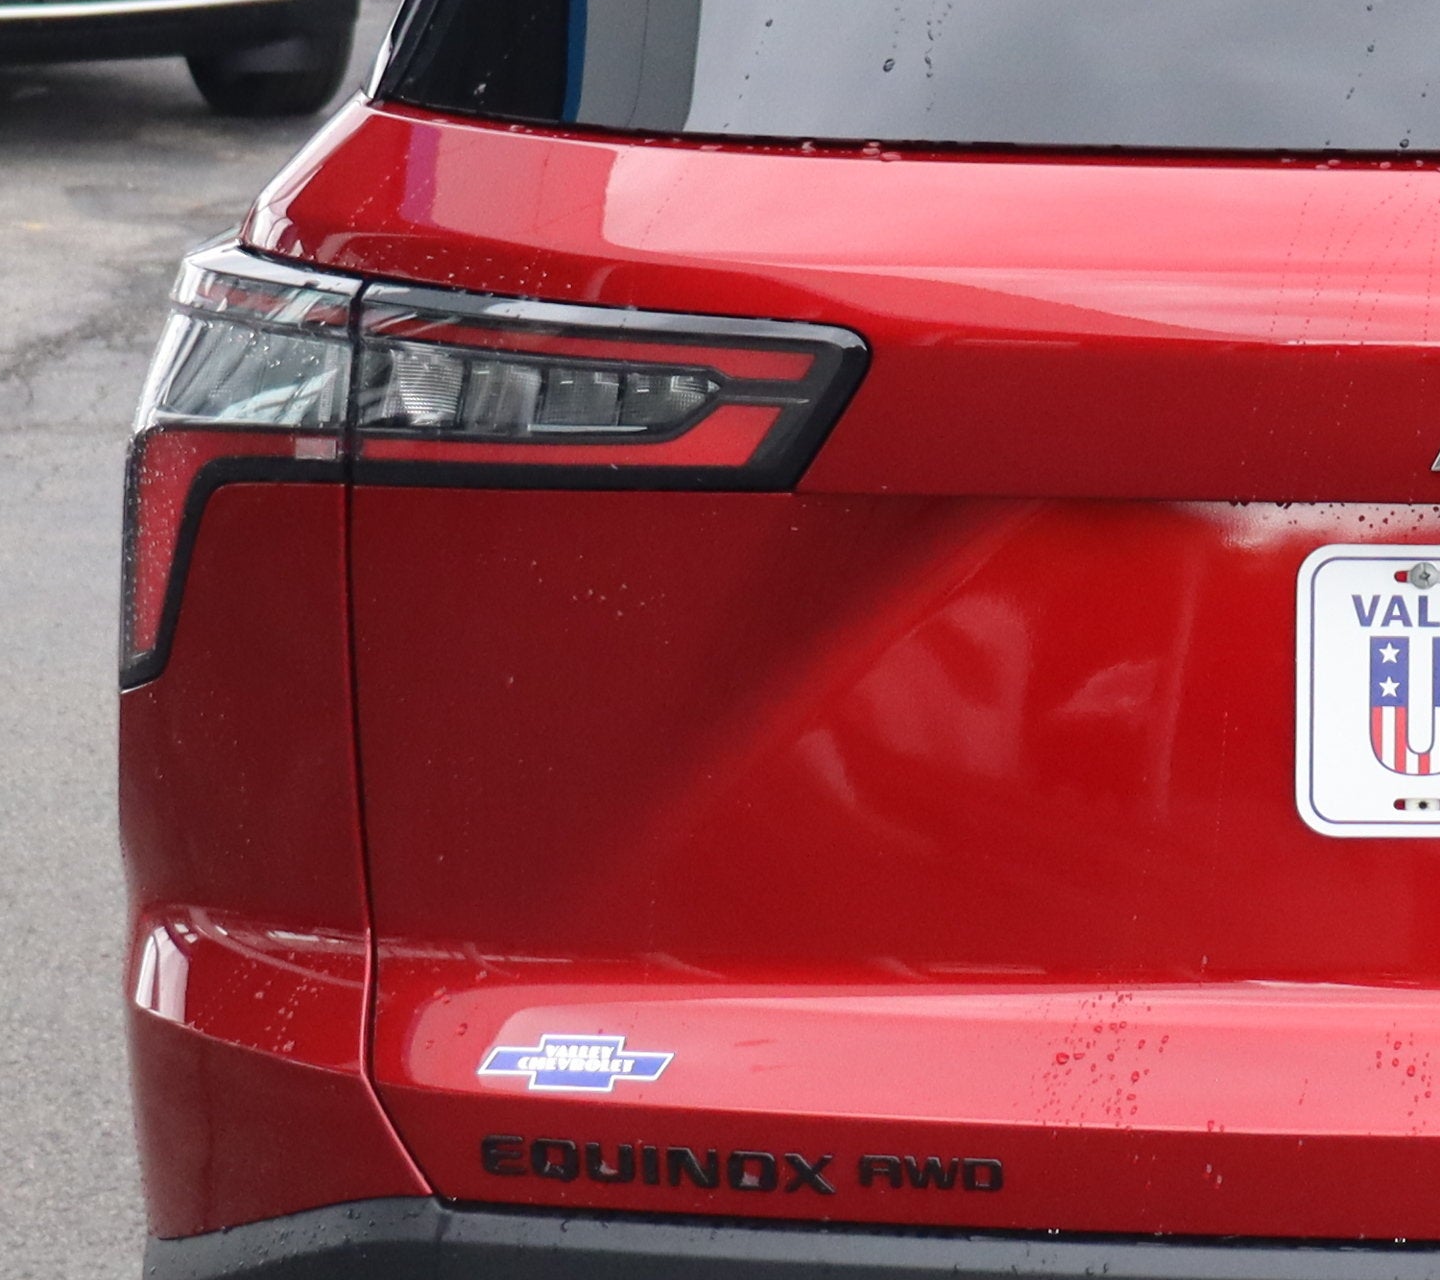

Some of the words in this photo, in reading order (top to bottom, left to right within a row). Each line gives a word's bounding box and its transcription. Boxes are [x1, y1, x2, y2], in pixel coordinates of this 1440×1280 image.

[545, 1045, 615, 1059] VALLEY
[517, 1057, 635, 1072] CHEVROLET
[480, 1135, 836, 1195] EQUINOX
[858, 1155, 1004, 1192] AWD
